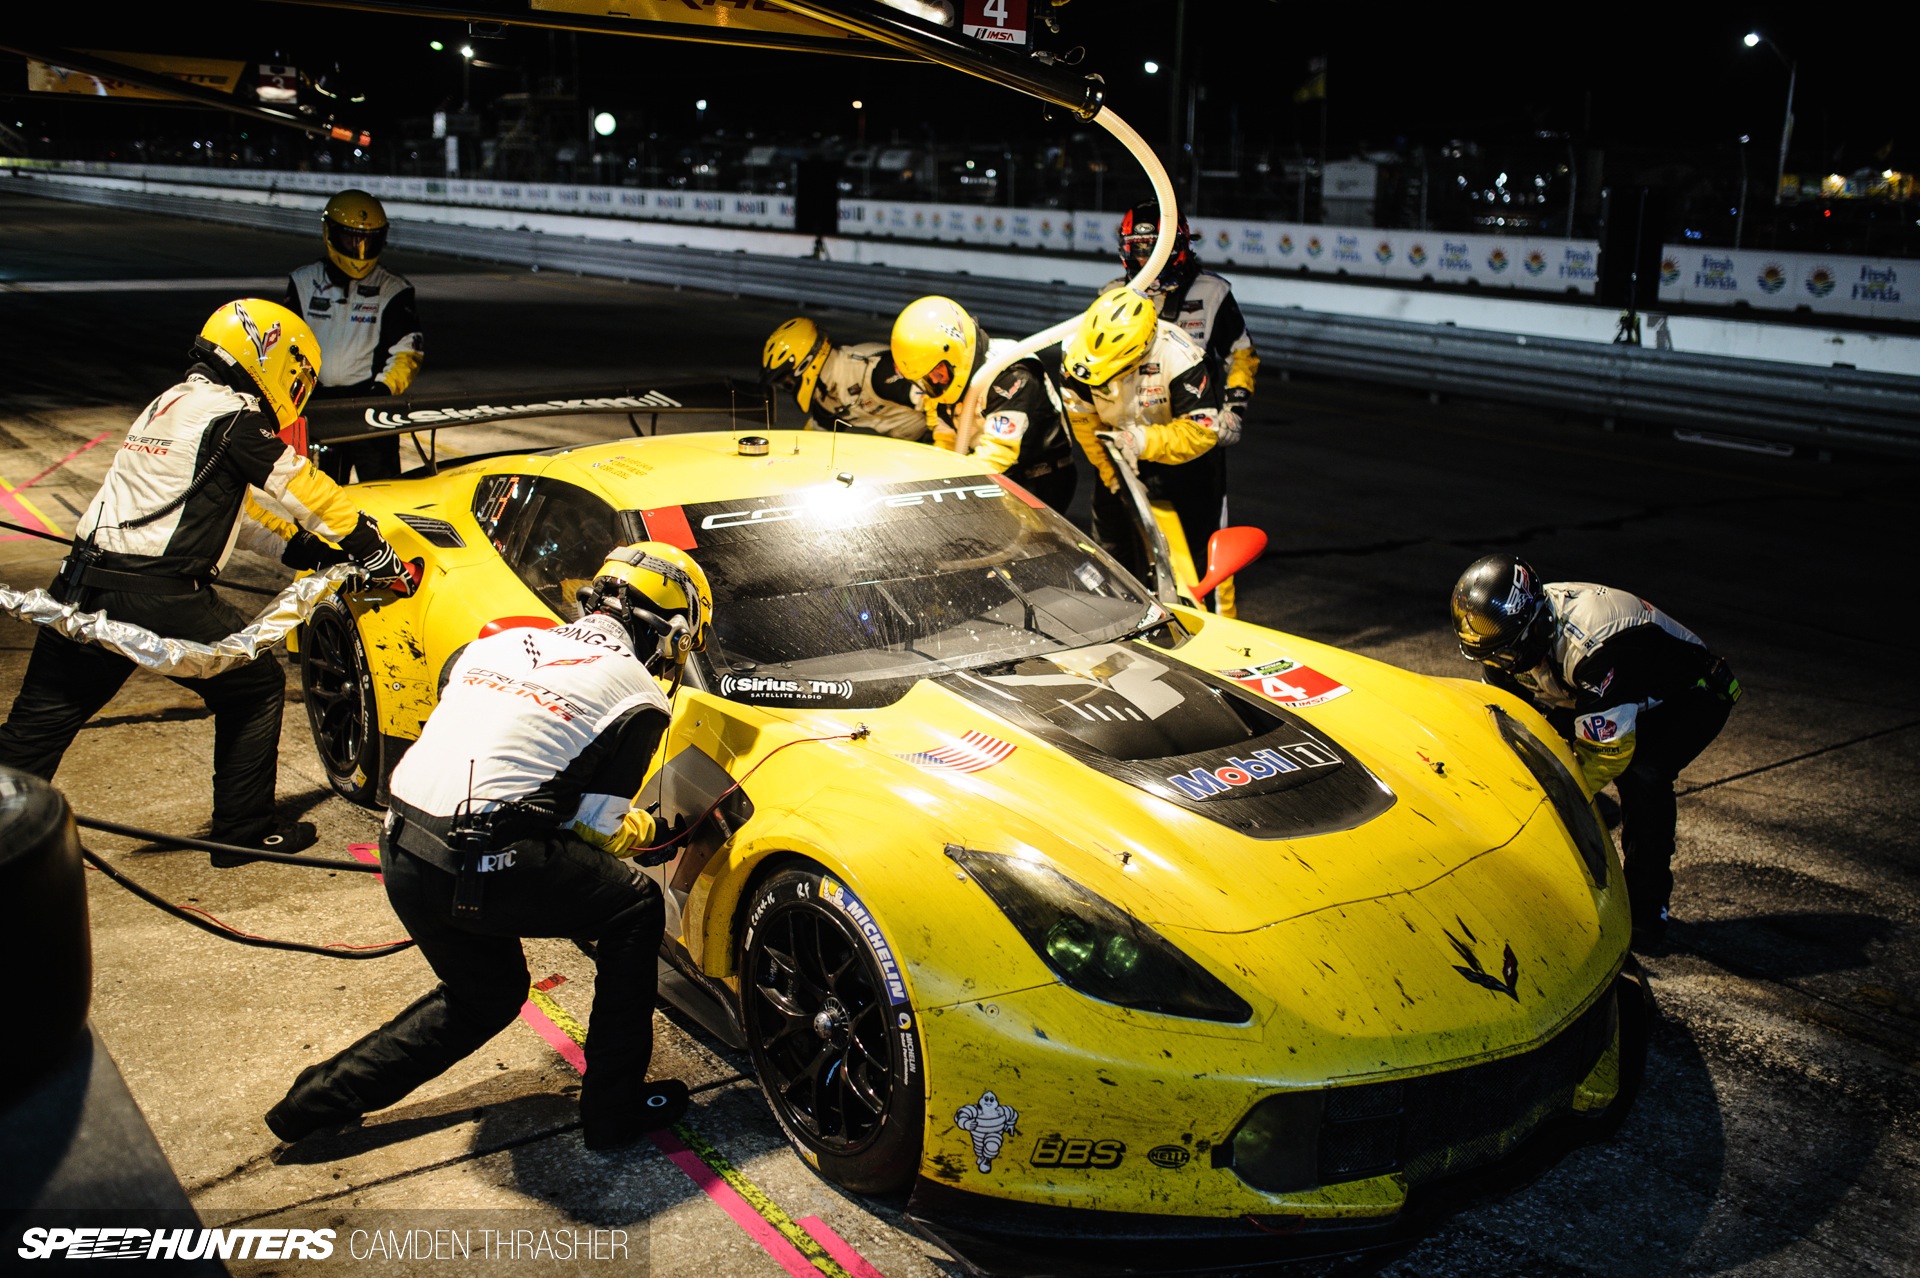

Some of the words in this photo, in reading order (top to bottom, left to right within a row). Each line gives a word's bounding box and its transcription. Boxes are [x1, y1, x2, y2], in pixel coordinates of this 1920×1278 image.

[983, 0, 1008, 27] 4
[986, 30, 1014, 41] IMSA
[122, 441, 169, 456] ACING
[128, 434, 174, 447] RVETTE
[701, 484, 1005, 530] COETTE
[462, 676, 575, 722] RACING
[467, 667, 587, 715] CORVETTE
[1261, 676, 1309, 700] 4
[1582, 715, 1606, 741] VP
[1166, 747, 1301, 801] Mobil
[847, 900, 905, 999] MICHELIN
[906, 1032, 917, 1073] MICHELIN
[1030, 1138, 1127, 1170] BBS
[1151, 1149, 1190, 1164] HELLA
